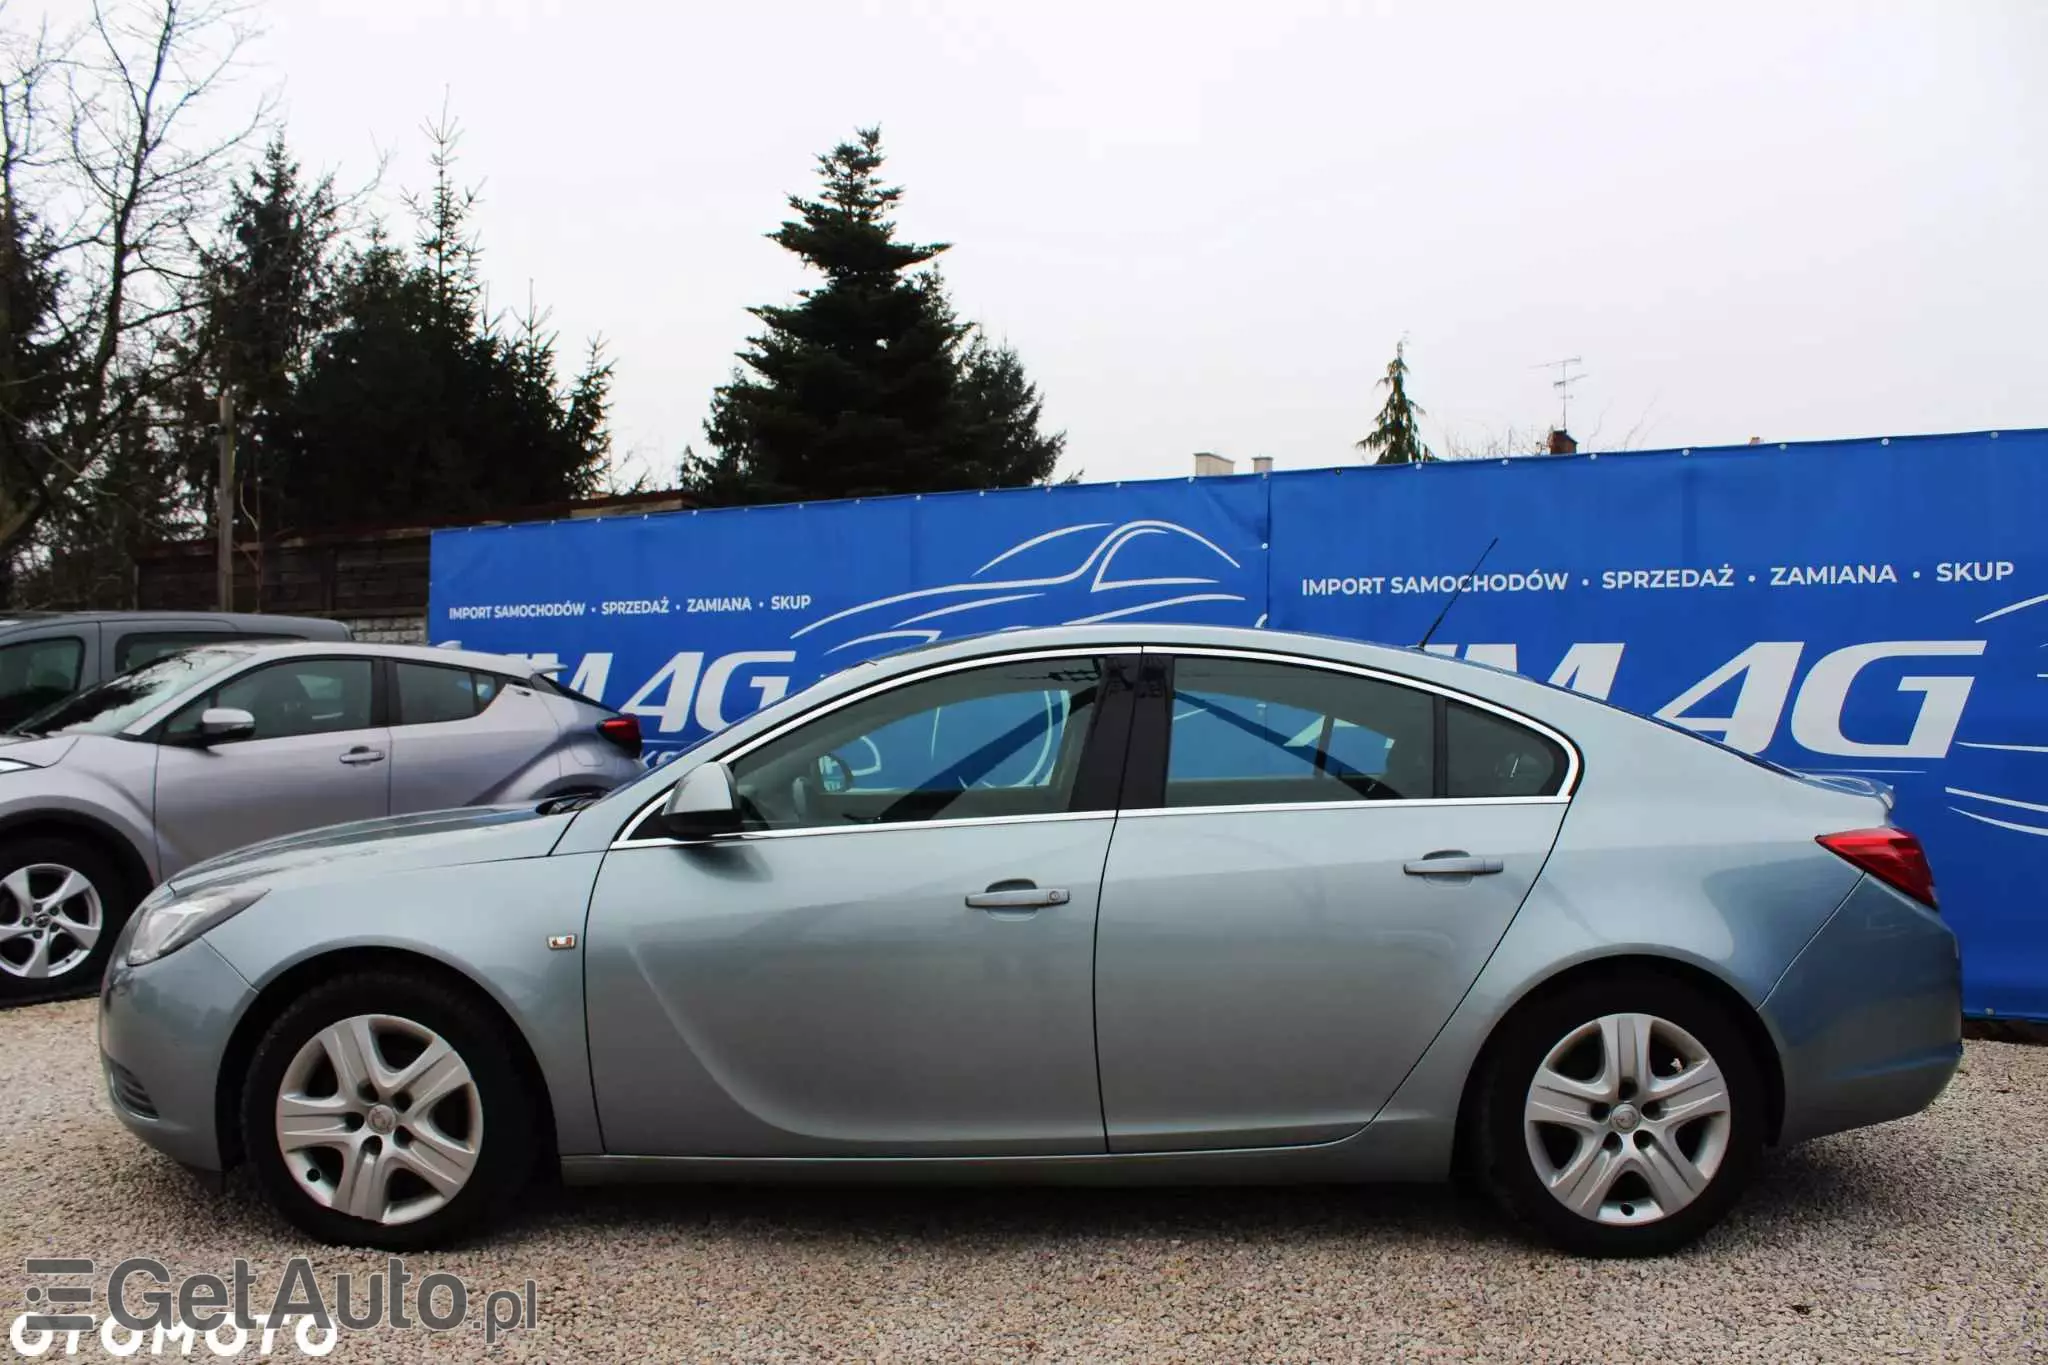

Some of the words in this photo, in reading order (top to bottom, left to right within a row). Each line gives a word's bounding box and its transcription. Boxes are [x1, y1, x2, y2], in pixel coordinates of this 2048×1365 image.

[1302, 575, 1384, 596] IMPORT
[1391, 568, 1569, 594] SAMOCHODÓW
[1602, 563, 1734, 589] SPRZEDAŻ
[1770, 564, 1897, 586] ZAMIANA
[1936, 561, 2014, 583] SKUP
[449, 606, 491, 620] IMPORT
[494, 601, 585, 618] SAMOCHODÓW
[601, 597, 670, 615] SPRZEDAŻ
[687, 598, 752, 613] ZAMIANA
[771, 595, 811, 610] SKUP
